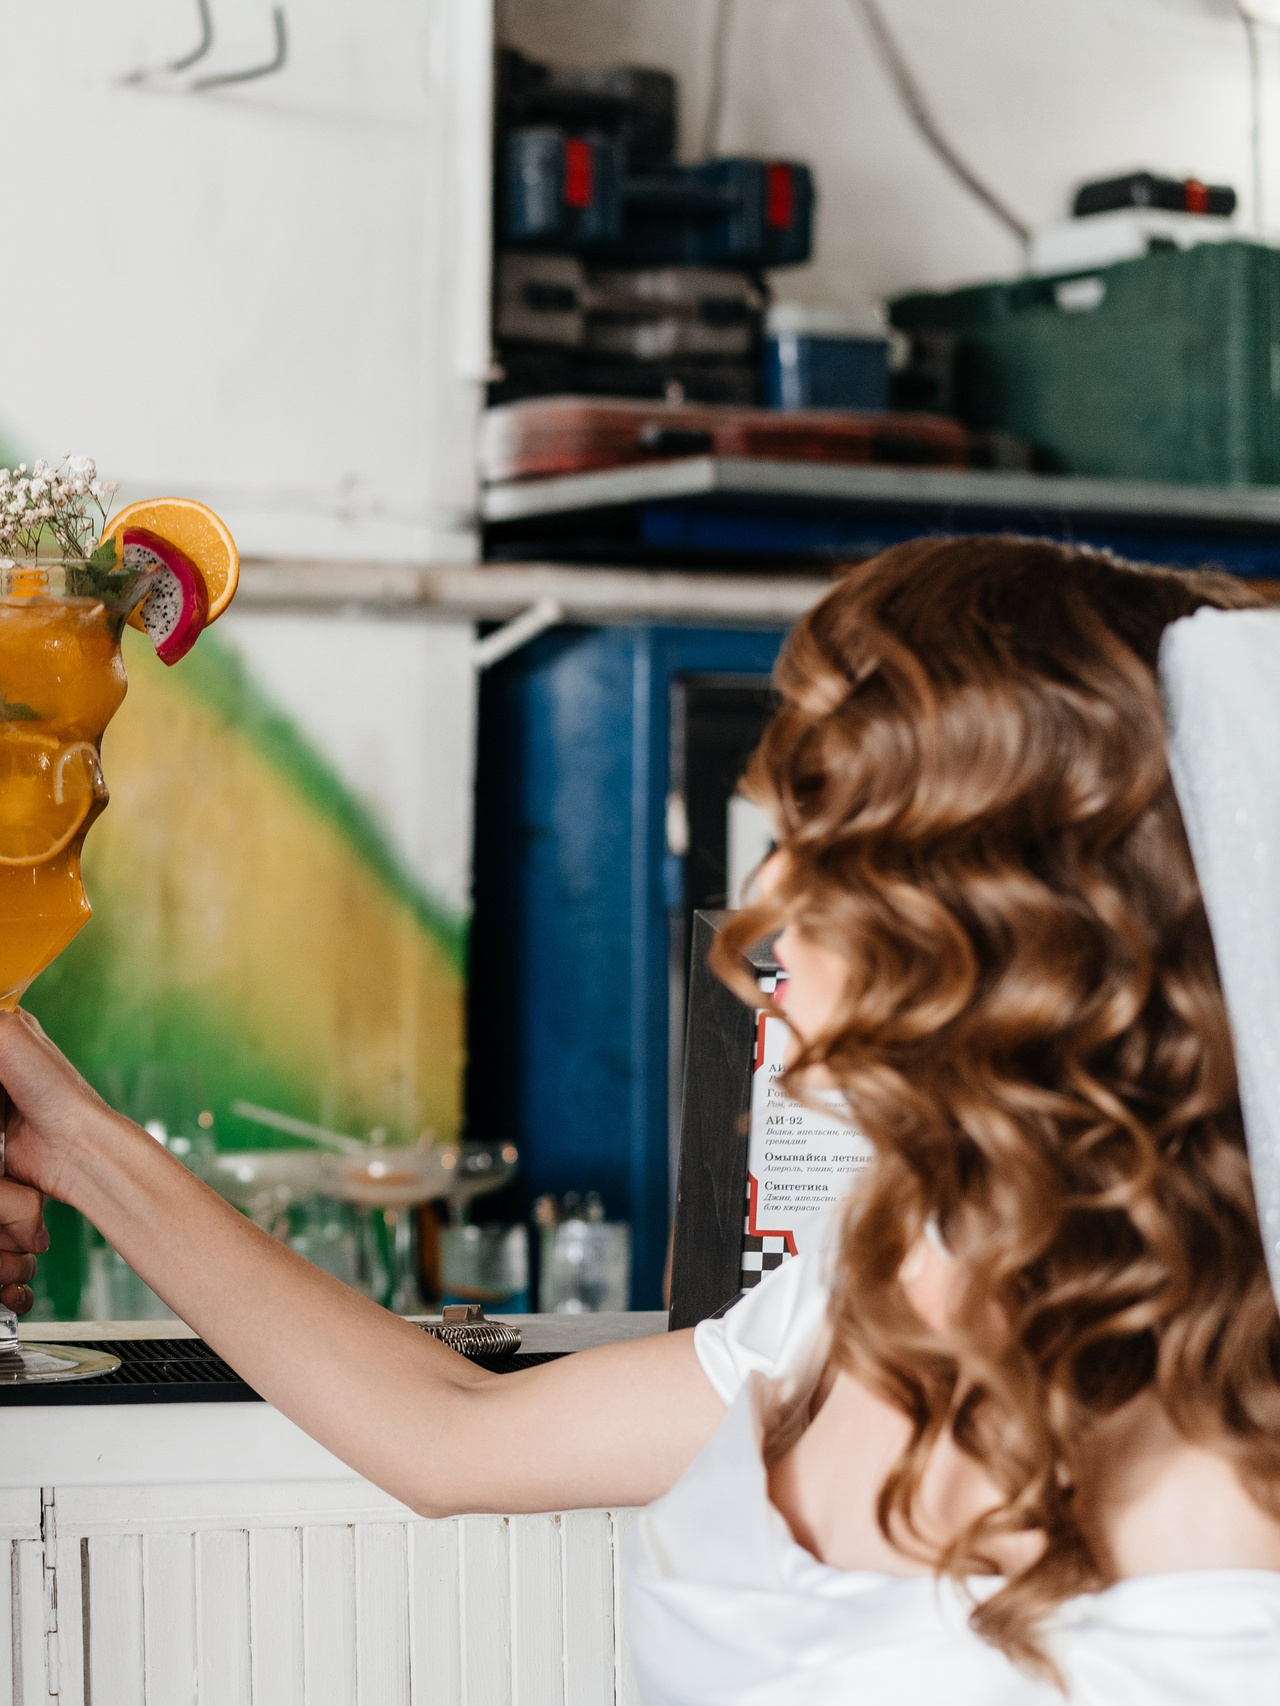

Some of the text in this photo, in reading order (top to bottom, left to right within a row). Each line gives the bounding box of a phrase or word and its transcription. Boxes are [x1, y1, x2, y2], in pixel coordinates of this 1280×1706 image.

[766, 1116, 803, 1125] АИ-92
[766, 1128, 795, 1136] Водка,
[764, 1152, 827, 1162] Омывайка
[764, 1181, 829, 1192] Синтетика
[763, 1193, 792, 1202] Джин,
[764, 1203, 782, 1211] блю
